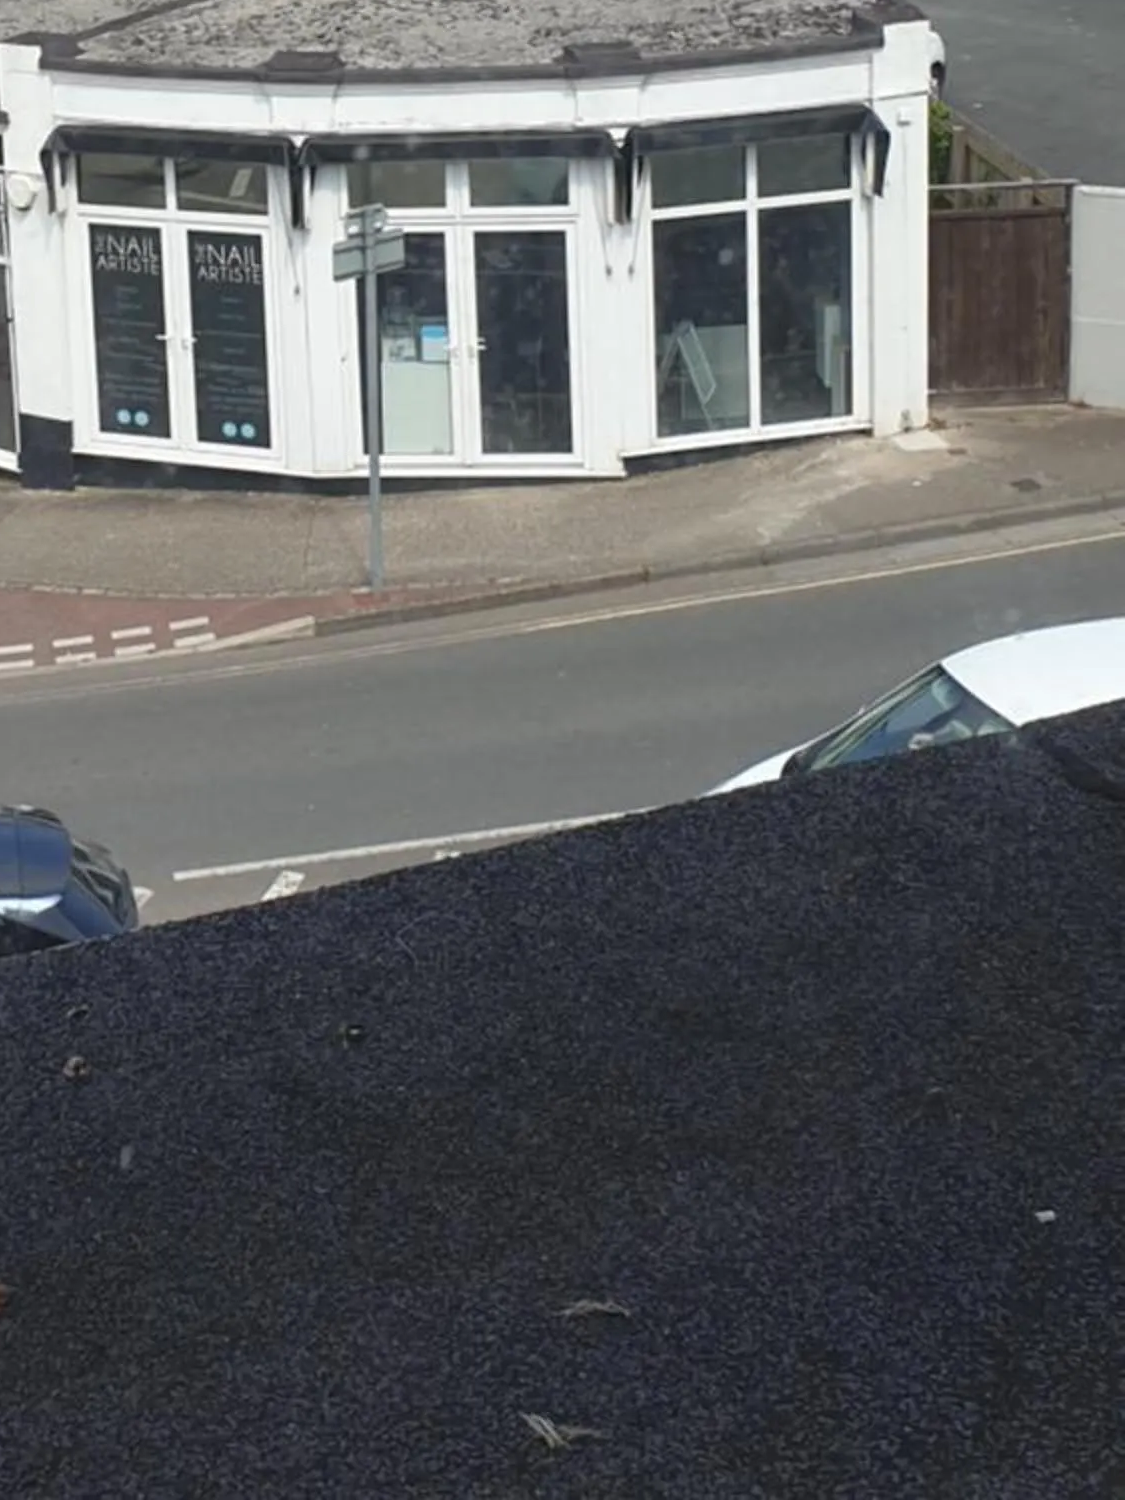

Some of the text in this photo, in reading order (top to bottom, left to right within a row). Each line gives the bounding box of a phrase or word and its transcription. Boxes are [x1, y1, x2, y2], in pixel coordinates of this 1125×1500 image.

[107, 233, 158, 259] NAIL
[207, 243, 258, 266] NAIL
[96, 253, 160, 276] ARTISTE
[197, 263, 263, 285] ARTISTE
